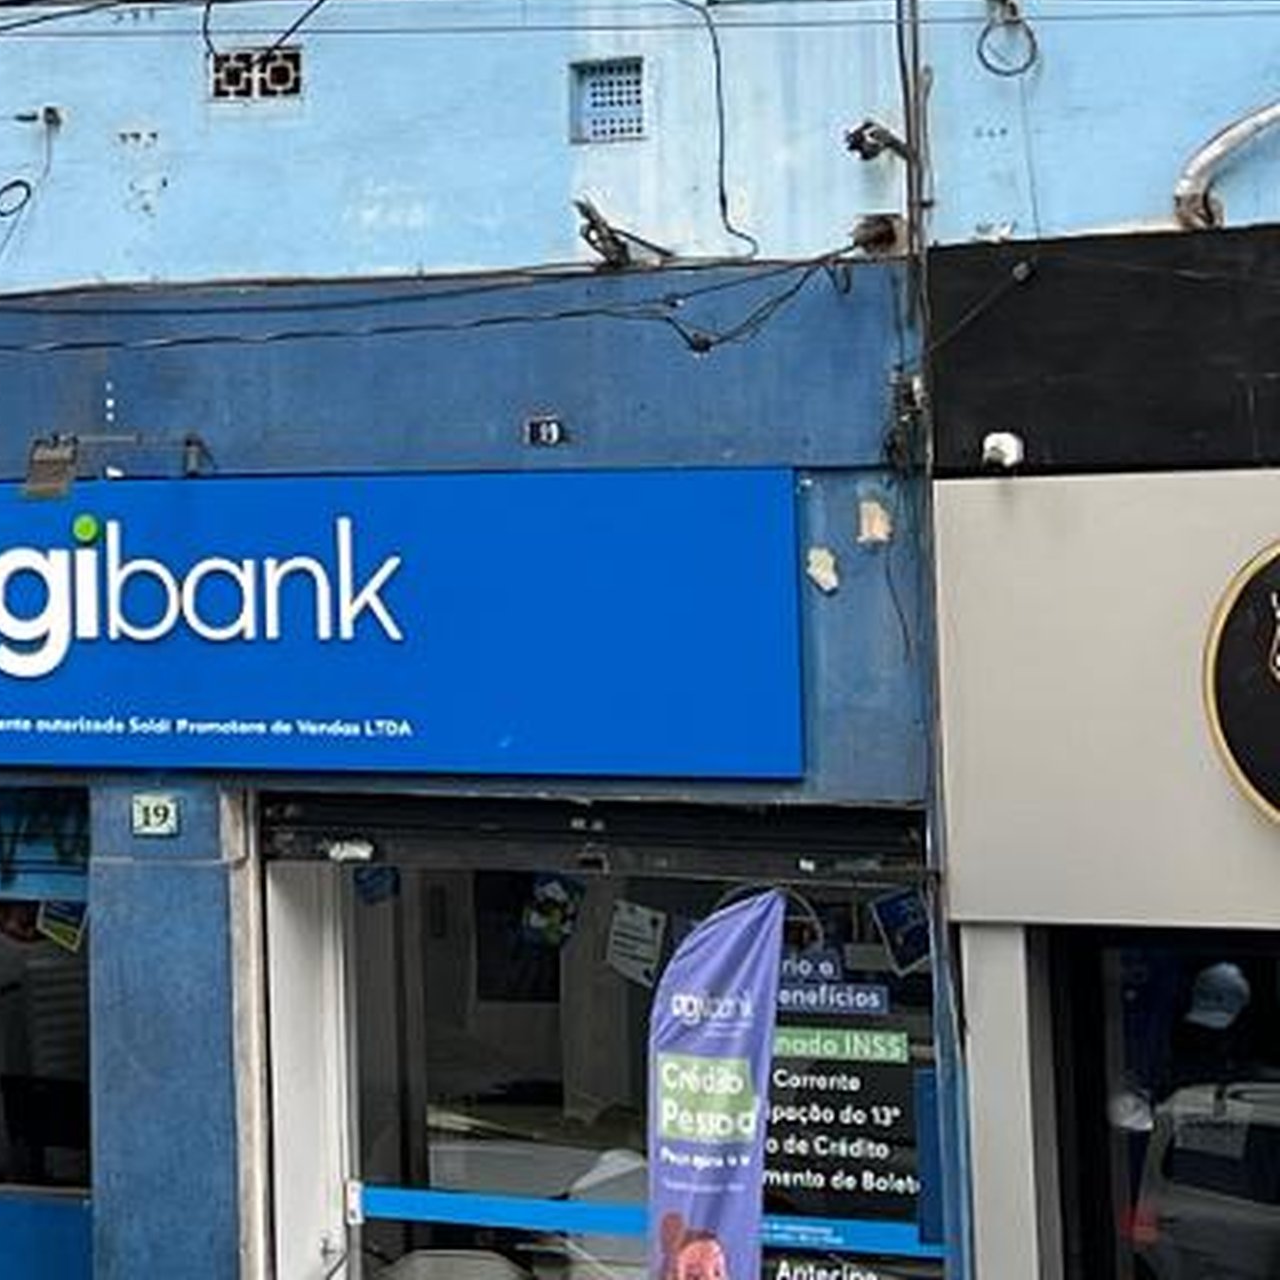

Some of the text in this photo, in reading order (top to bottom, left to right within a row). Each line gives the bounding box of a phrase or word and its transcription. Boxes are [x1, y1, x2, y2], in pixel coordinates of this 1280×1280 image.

[36, 715, 125, 734] autorizado
[175, 718, 266, 735] Promotora
[270, 719, 293, 735] de
[296, 719, 360, 736] Vendas
[364, 719, 413, 737] LTDA
[143, 805, 170, 827] 19
[844, 1032, 903, 1061] INSS
[772, 1069, 861, 1093] Corrente
[782, 1134, 810, 1157] de
[830, 1169, 857, 1192] de
